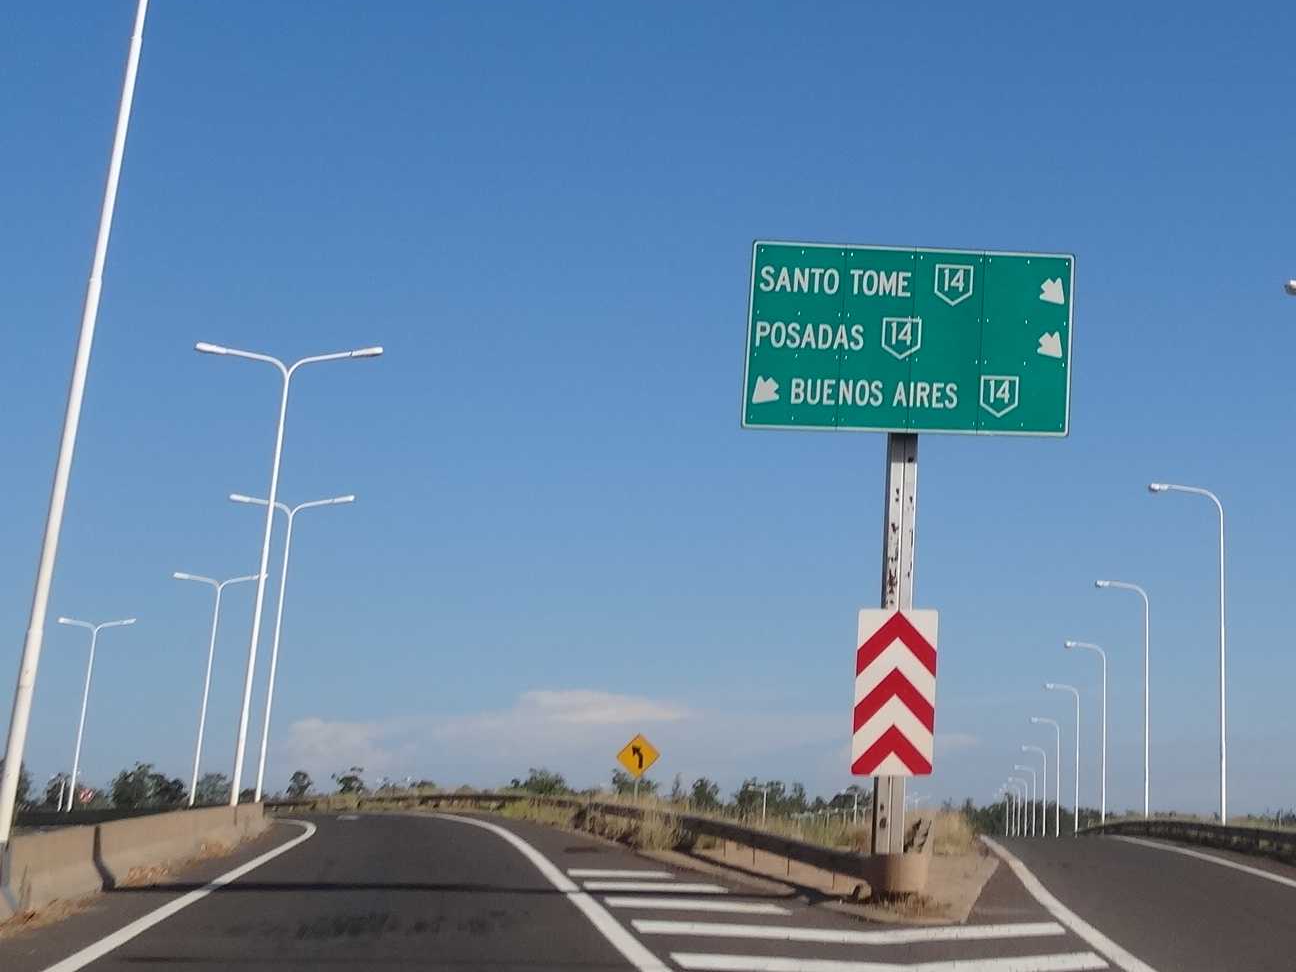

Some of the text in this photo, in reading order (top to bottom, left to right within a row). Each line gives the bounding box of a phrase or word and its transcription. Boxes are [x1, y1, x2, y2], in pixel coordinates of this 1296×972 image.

[759, 266, 965, 297] SANTO TOME 14
[755, 321, 912, 350] POSADAS 14
[790, 378, 1011, 408] BUENOS AIRES 14
